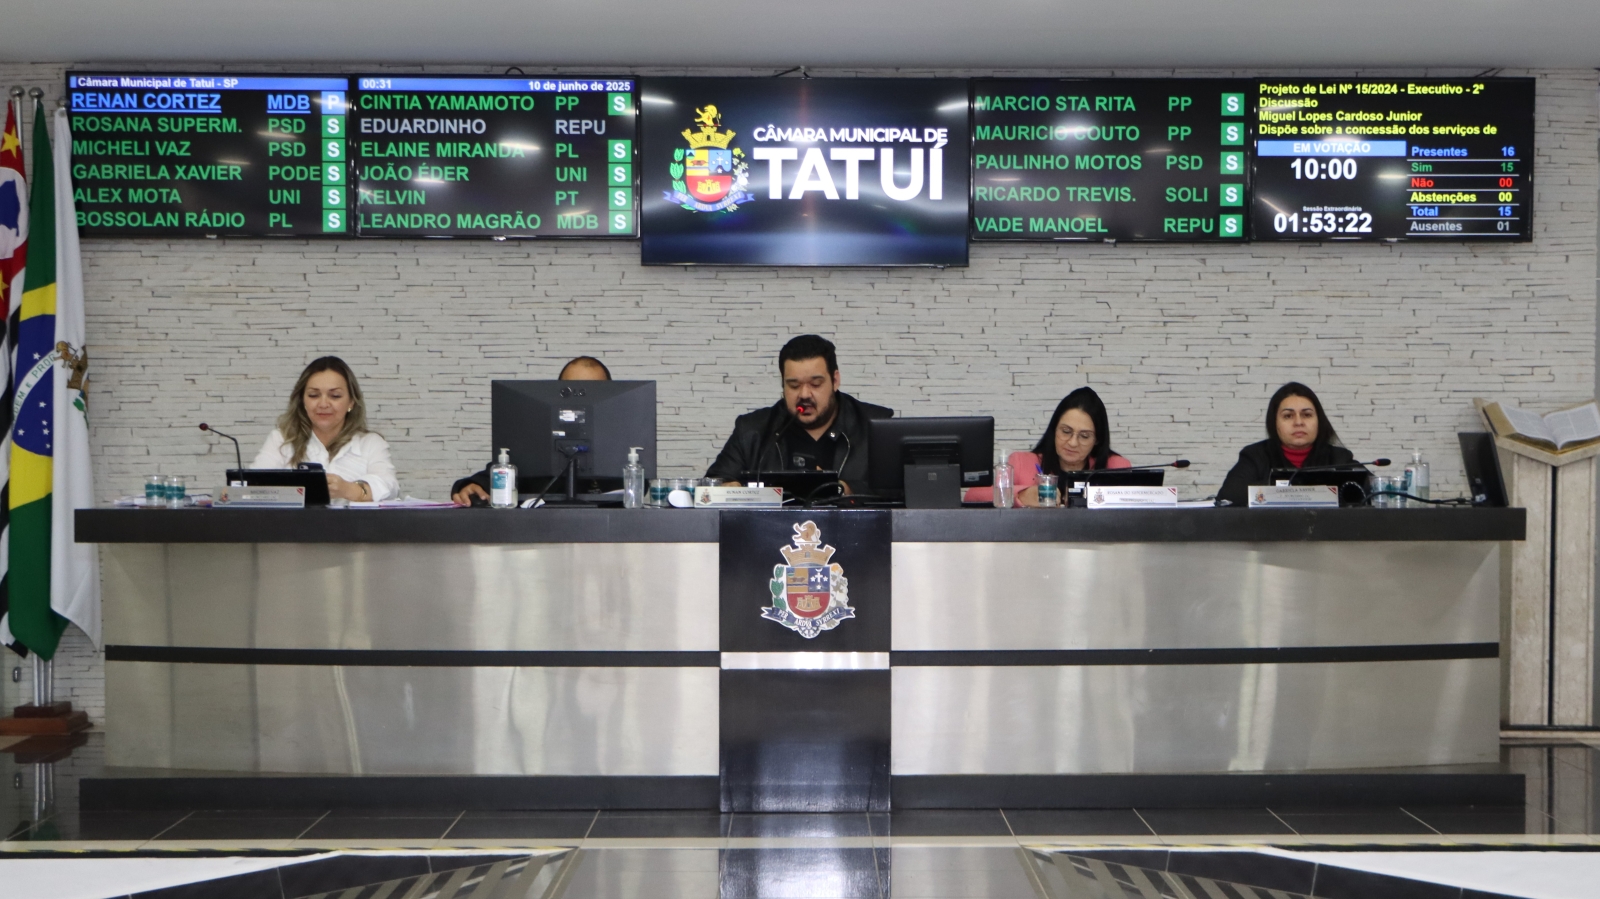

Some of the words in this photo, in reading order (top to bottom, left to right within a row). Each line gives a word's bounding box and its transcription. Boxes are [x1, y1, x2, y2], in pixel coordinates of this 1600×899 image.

[78, 77, 118, 87] Câmara
[121, 78, 171, 89] Municipal
[174, 78, 186, 88] de
[224, 79, 238, 88] SP
[363, 80, 391, 89] 00:31
[528, 81, 540, 90] 10
[543, 81, 556, 90] de
[558, 81, 588, 92] junho
[591, 81, 604, 91] de
[606, 81, 630, 91] 2025
[1260, 84, 1300, 96] Projeto
[1303, 84, 1316, 94] de
[1320, 84, 1336, 94] Lei
[1355, 84, 1398, 94] 15/2024
[1408, 84, 1463, 94] Executivo
[72, 93, 137, 109] RENAN
[143, 93, 221, 109] CORTEZ
[267, 94, 310, 110] MDB
[328, 95, 339, 110] P
[360, 95, 422, 110] CINTIA
[427, 95, 534, 110] YAMAMOTO
[555, 96, 579, 110] PP
[613, 96, 626, 111] S
[976, 96, 1050, 110] MARCIO
[1055, 96, 1090, 111] STA
[1095, 97, 1136, 111] RITA
[1168, 97, 1192, 111] PP
[1226, 97, 1239, 112] S
[1260, 97, 1318, 107] Discussão
[1259, 111, 1295, 123] Miguel
[1299, 111, 1333, 123] Lopes
[1336, 111, 1383, 121] Cardoso
[1386, 111, 1422, 121] Junior
[72, 118, 152, 132] ROSANA
[158, 118, 242, 133] SUPERM.
[268, 119, 305, 133] PSD
[327, 119, 340, 134] S
[360, 119, 486, 134] EDUARDINHO
[556, 120, 606, 134] REPU
[753, 124, 828, 142] CÂMARA
[830, 128, 922, 142] MUNICIPAL
[924, 129, 948, 142] DE
[976, 126, 1068, 140] MAURICIO
[1074, 126, 1140, 141] COUTO
[1168, 127, 1191, 140] PP
[1226, 126, 1238, 141] S
[1259, 124, 1298, 136] Dispõe
[1301, 124, 1332, 134] sobre
[1345, 124, 1405, 134] concessão
[1409, 125, 1429, 134] dos
[1433, 124, 1480, 136] serviços
[1483, 125, 1497, 134] de
[73, 141, 150, 156] MICHELI
[156, 142, 191, 156] VAZ
[268, 143, 306, 157] PSD
[327, 142, 340, 157] S
[360, 142, 430, 157] ELAINE
[436, 143, 525, 158] MIRANDA
[556, 144, 579, 158] PL
[613, 144, 626, 158] S
[1294, 143, 1310, 152] EM
[1312, 141, 1370, 153] VOTAÇÃO
[1411, 147, 1467, 157] Presentes
[1502, 147, 1514, 156] 16
[975, 155, 1069, 169] PAULINHO
[1075, 155, 1142, 170] MOTOS
[1166, 156, 1203, 170] PSD
[1226, 155, 1238, 170] S
[1291, 159, 1357, 179] 10:00
[1411, 163, 1432, 172] Sim
[1501, 163, 1513, 172] 15
[73, 165, 172, 180] GABRIELA
[175, 166, 242, 180] XAVIER
[269, 166, 321, 180] PODE
[327, 166, 340, 181] S
[360, 162, 412, 181] JOÃO
[418, 162, 469, 181] ÉDER
[556, 167, 587, 182] UNI
[614, 167, 626, 182] S
[753, 142, 948, 200] TATUÍ
[1411, 178, 1433, 188] Não
[1500, 178, 1512, 187] 00
[74, 188, 123, 203] ALEX
[128, 189, 182, 203] MOTA
[269, 190, 300, 204] UNI
[328, 190, 340, 205] S
[360, 190, 426, 204] KELVIN
[556, 191, 579, 205] PT
[614, 191, 626, 206] S
[975, 187, 1060, 201] RICARDO
[1066, 187, 1136, 202] TREVIS.
[1165, 188, 1208, 202] SOLI
[1225, 187, 1238, 202] S
[1411, 192, 1476, 203] Abstenções
[1499, 193, 1512, 202] 00
[76, 212, 179, 227] BOSSOLAN
[185, 209, 245, 227] RÁDIO
[269, 214, 292, 227] PL
[328, 213, 340, 229] S
[1411, 207, 1438, 216] Total
[1499, 207, 1511, 216] 15
[360, 214, 451, 228] LEANDRO
[457, 211, 541, 229] MAGRÃO
[557, 215, 599, 229] MDB
[614, 214, 626, 230] S
[975, 218, 1023, 232] VADE
[1029, 218, 1108, 232] MANOEL
[1164, 218, 1214, 232] REPU
[1225, 218, 1237, 233] S
[1274, 213, 1372, 232] 01:53:22
[1410, 221, 1462, 231] Ausentes
[1497, 222, 1509, 231] 01
